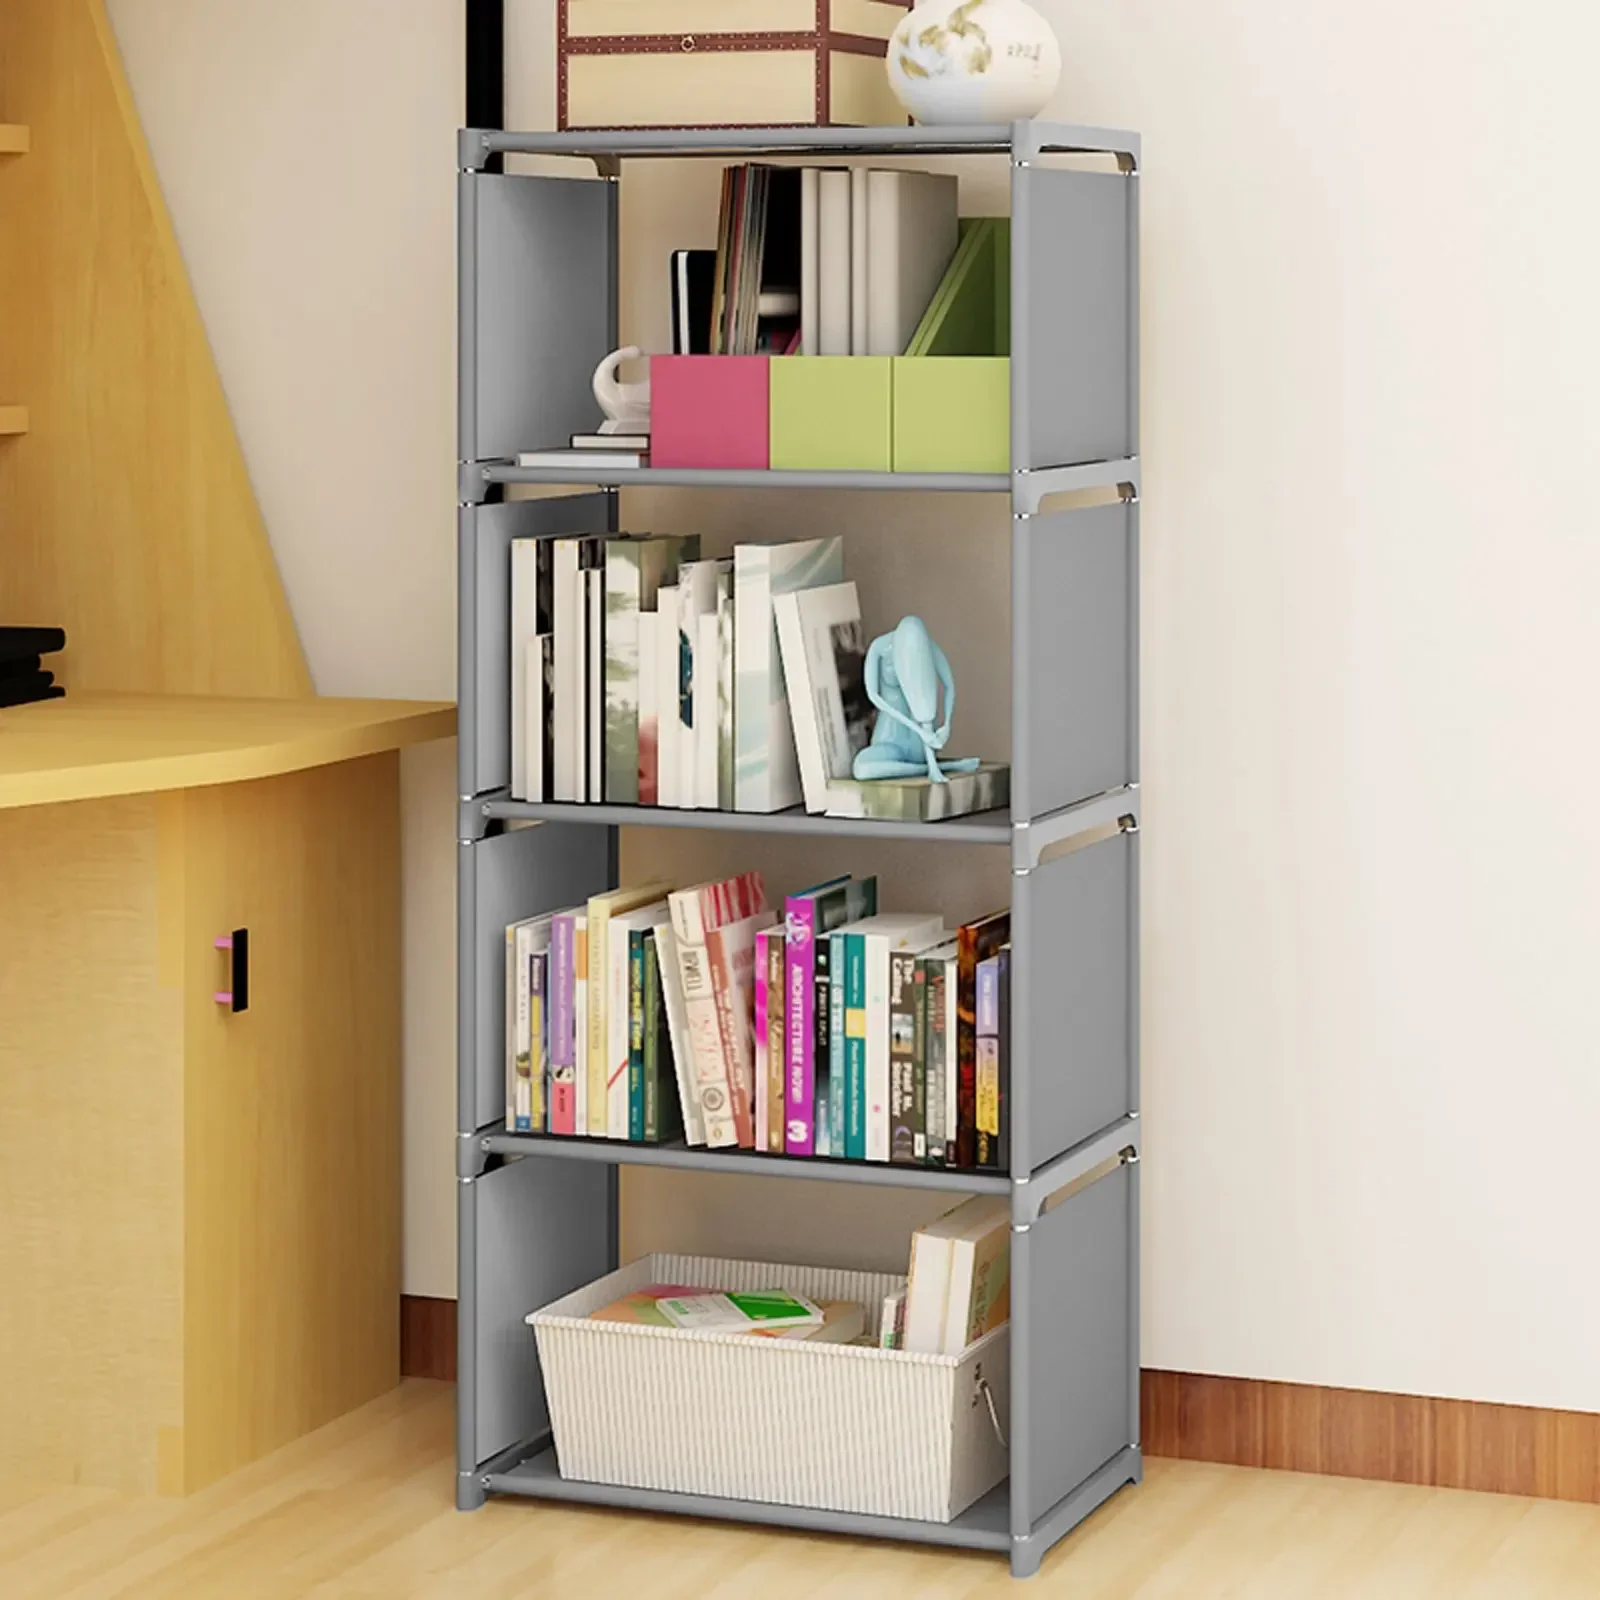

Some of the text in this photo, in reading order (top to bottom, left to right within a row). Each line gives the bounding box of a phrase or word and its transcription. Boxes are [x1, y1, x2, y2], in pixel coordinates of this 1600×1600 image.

[903, 958, 915, 985] The
[791, 963, 804, 1064] ARCHITECTURE
[787, 1119, 808, 1143] 3
